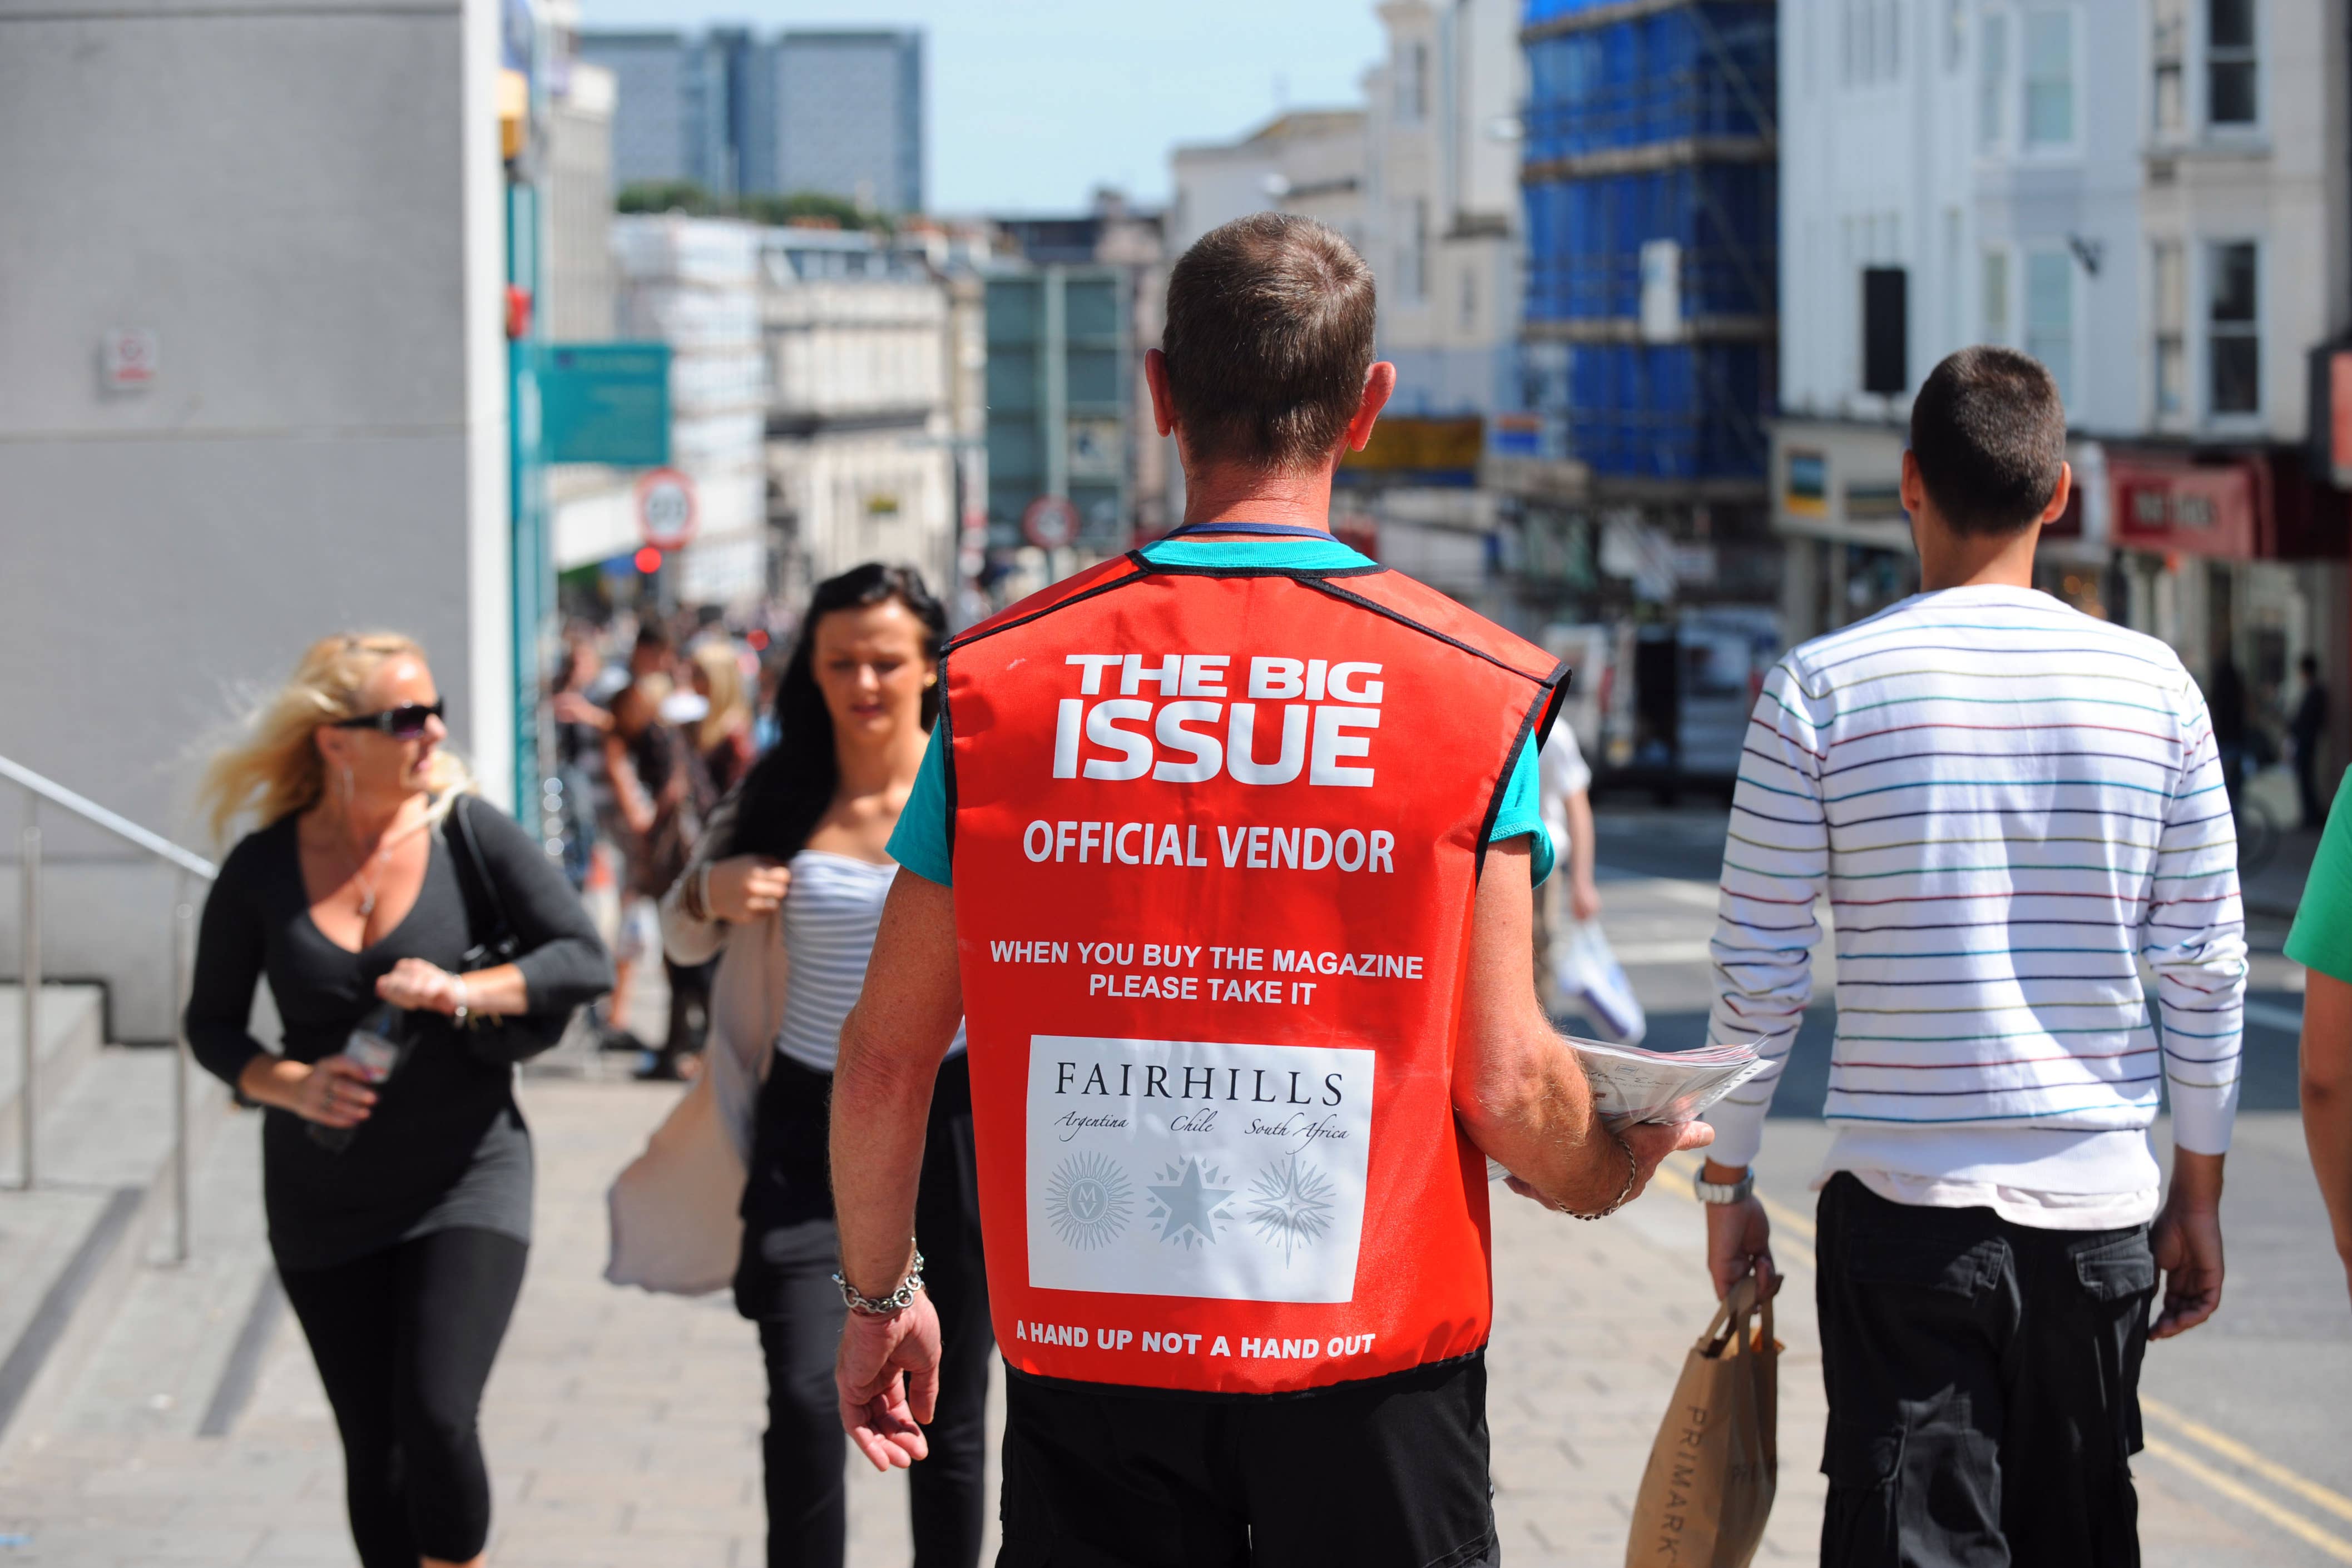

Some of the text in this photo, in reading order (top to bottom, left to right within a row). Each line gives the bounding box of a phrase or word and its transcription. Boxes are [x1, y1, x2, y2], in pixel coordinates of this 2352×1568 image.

[1065, 654, 1384, 704] THE BIG
[1053, 698, 1381, 787] ISSUE
[1023, 820, 1395, 874] OFFICIAL VENDOR
[990, 940, 1424, 980] WHEN YOU BUY THE MAGAZINE
[1089, 974, 1317, 1005] PLEASE TAKE IT
[1054, 1061, 1343, 1106] FAIRHILLS
[1054, 1108, 1351, 1155] Argentina Chile South Africa
[1016, 1319, 1376, 1359] A HAND UP NOT A HAND OUT
[1657, 1405, 1708, 1555] PRIMARK
